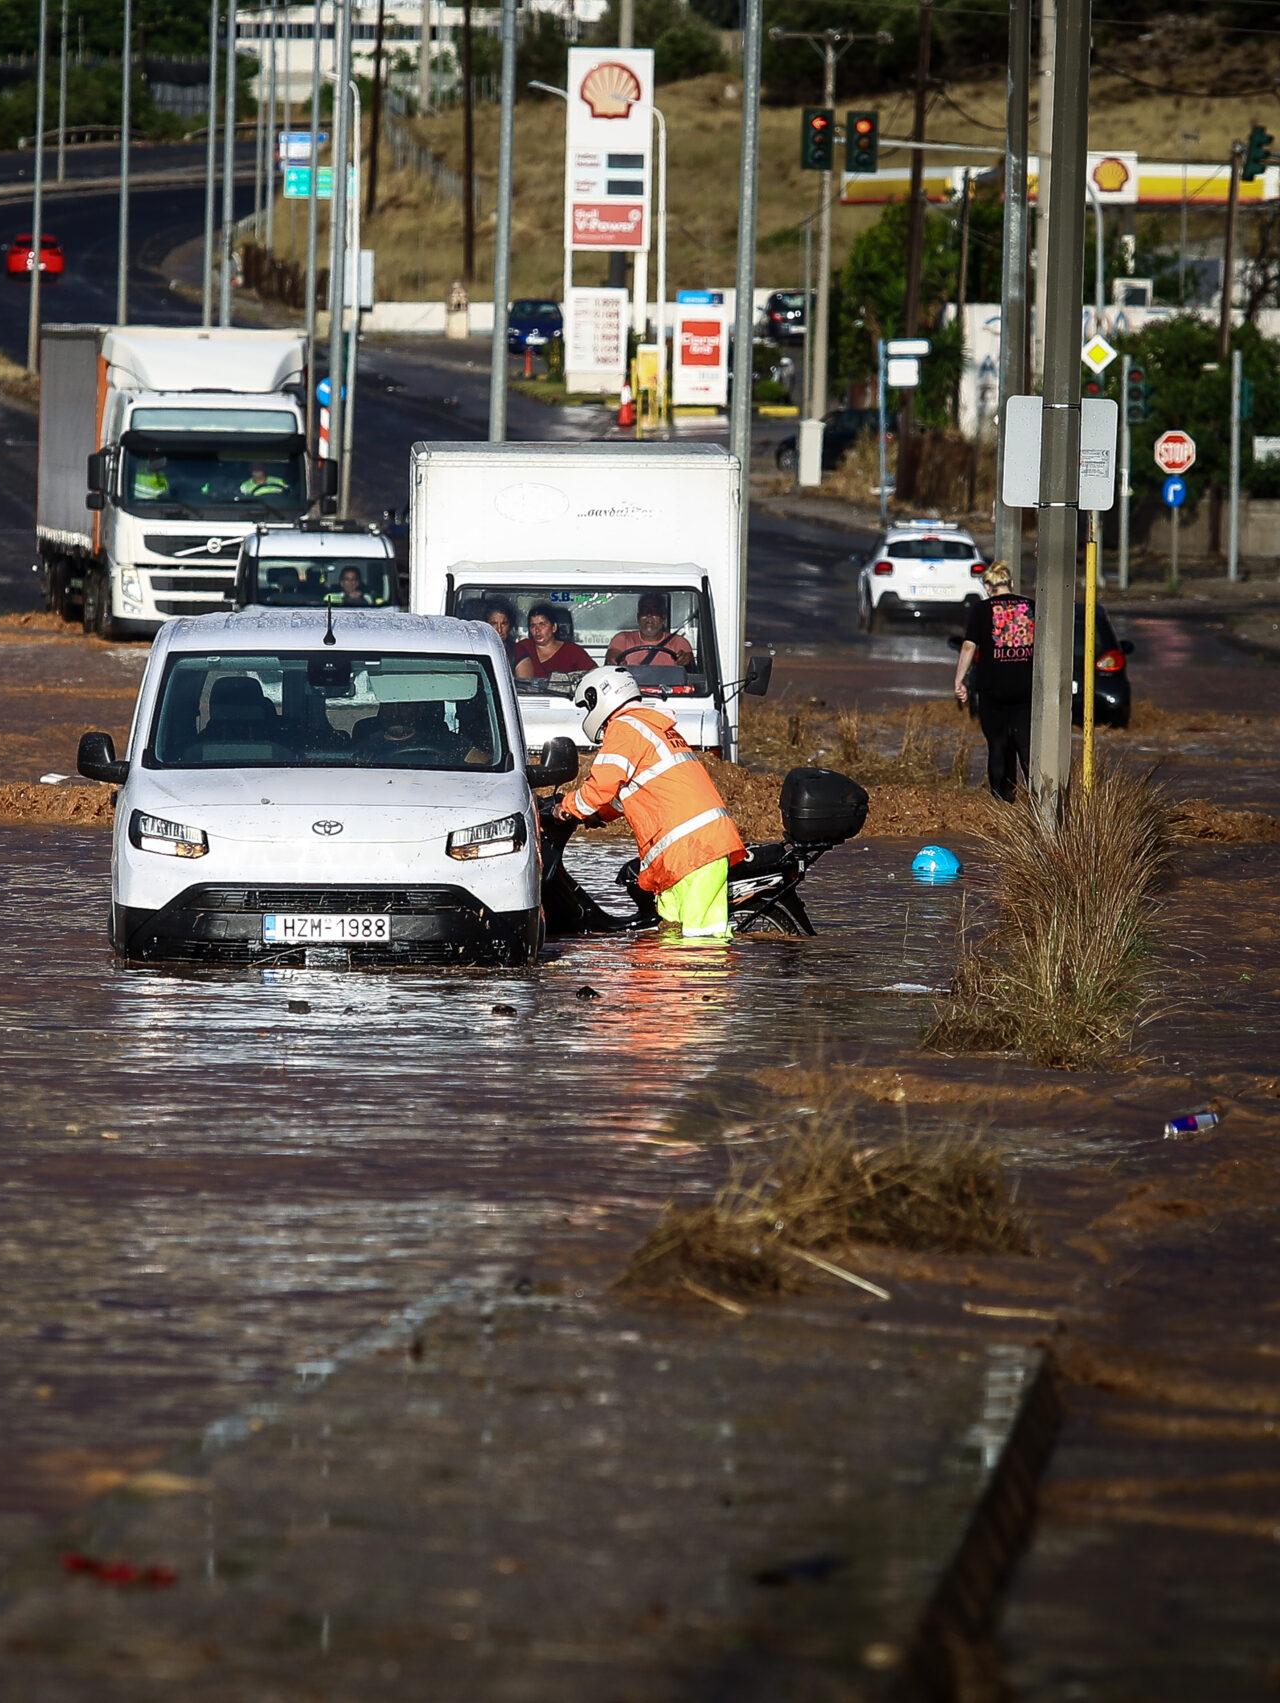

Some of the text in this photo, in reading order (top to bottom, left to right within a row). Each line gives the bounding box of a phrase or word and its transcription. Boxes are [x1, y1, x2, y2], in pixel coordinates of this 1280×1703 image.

[1159, 442, 1193, 463] STOP
[993, 647, 1035, 659] BLOOM
[284, 918, 386, 938] HZM-1988
